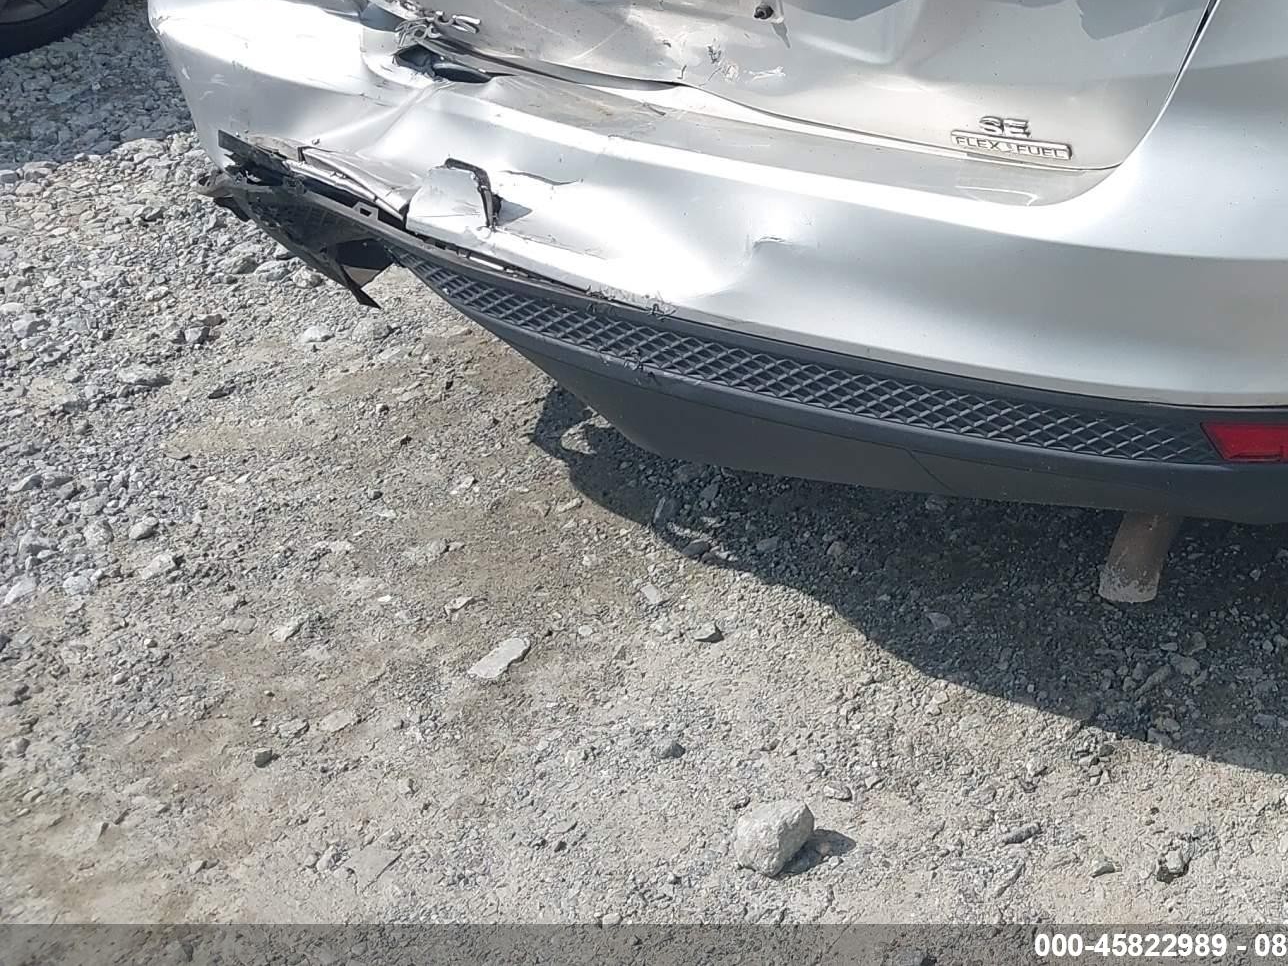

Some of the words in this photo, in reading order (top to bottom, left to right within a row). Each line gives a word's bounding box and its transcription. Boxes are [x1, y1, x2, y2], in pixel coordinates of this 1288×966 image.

[979, 115, 1032, 138] SE
[955, 136, 1001, 151] FLEX
[1016, 144, 1067, 159] FUEL
